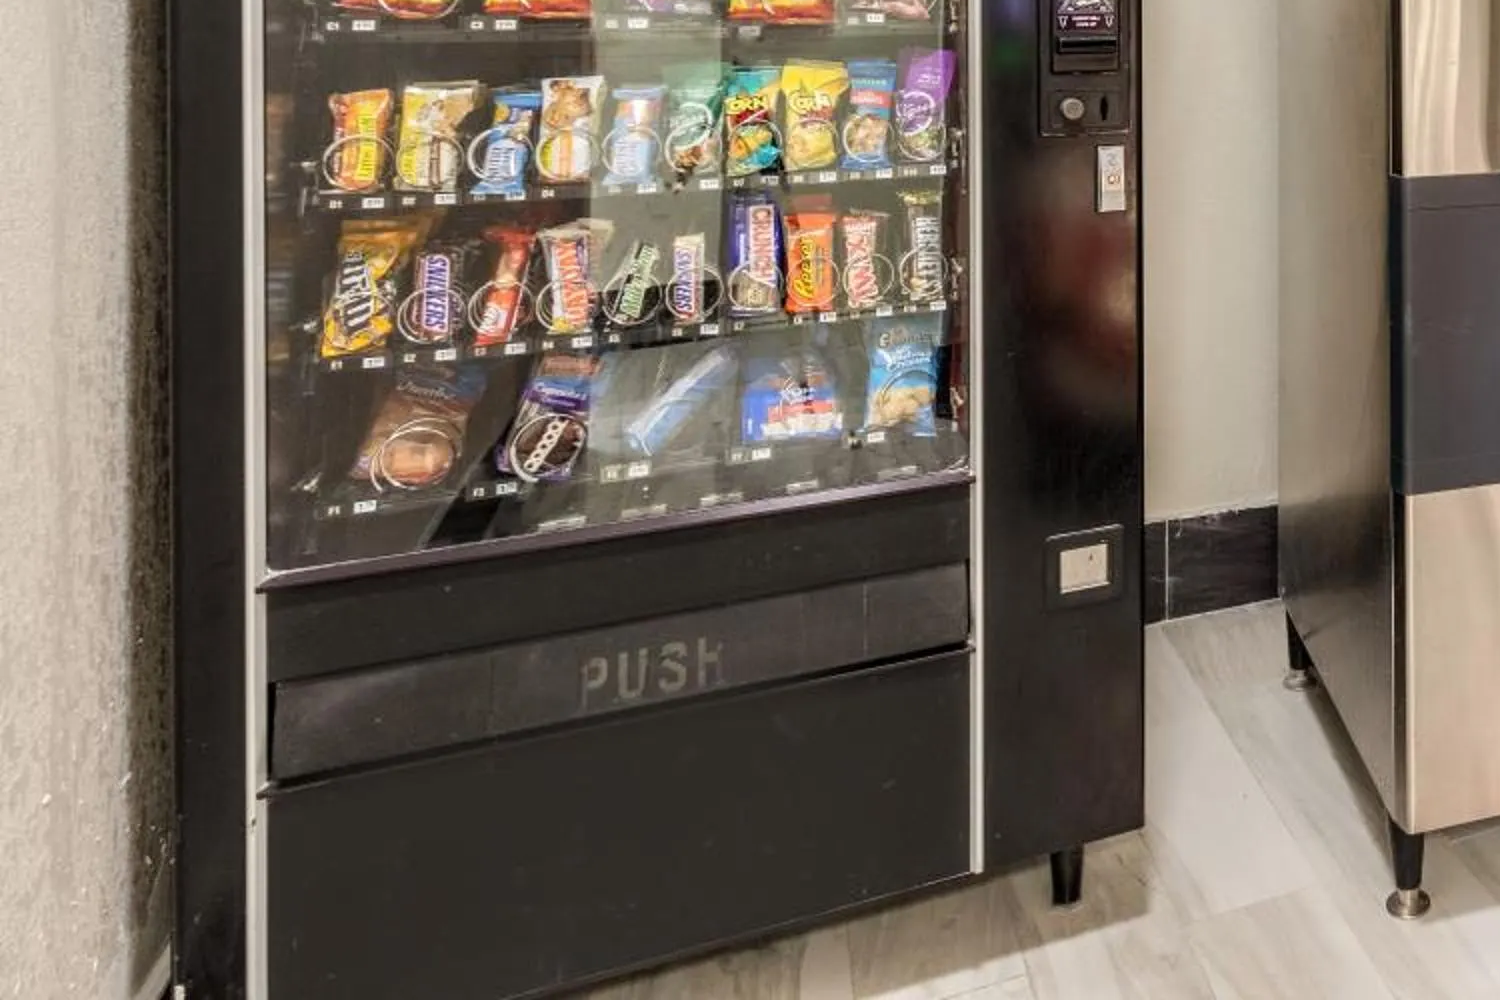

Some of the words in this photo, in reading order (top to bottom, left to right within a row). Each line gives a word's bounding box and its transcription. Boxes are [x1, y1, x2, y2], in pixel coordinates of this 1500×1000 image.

[751, 207, 773, 279] CRUNCH
[426, 255, 448, 330] SNICKERS
[675, 249, 694, 311] SNICKERS
[580, 637, 725, 708] PUSH
